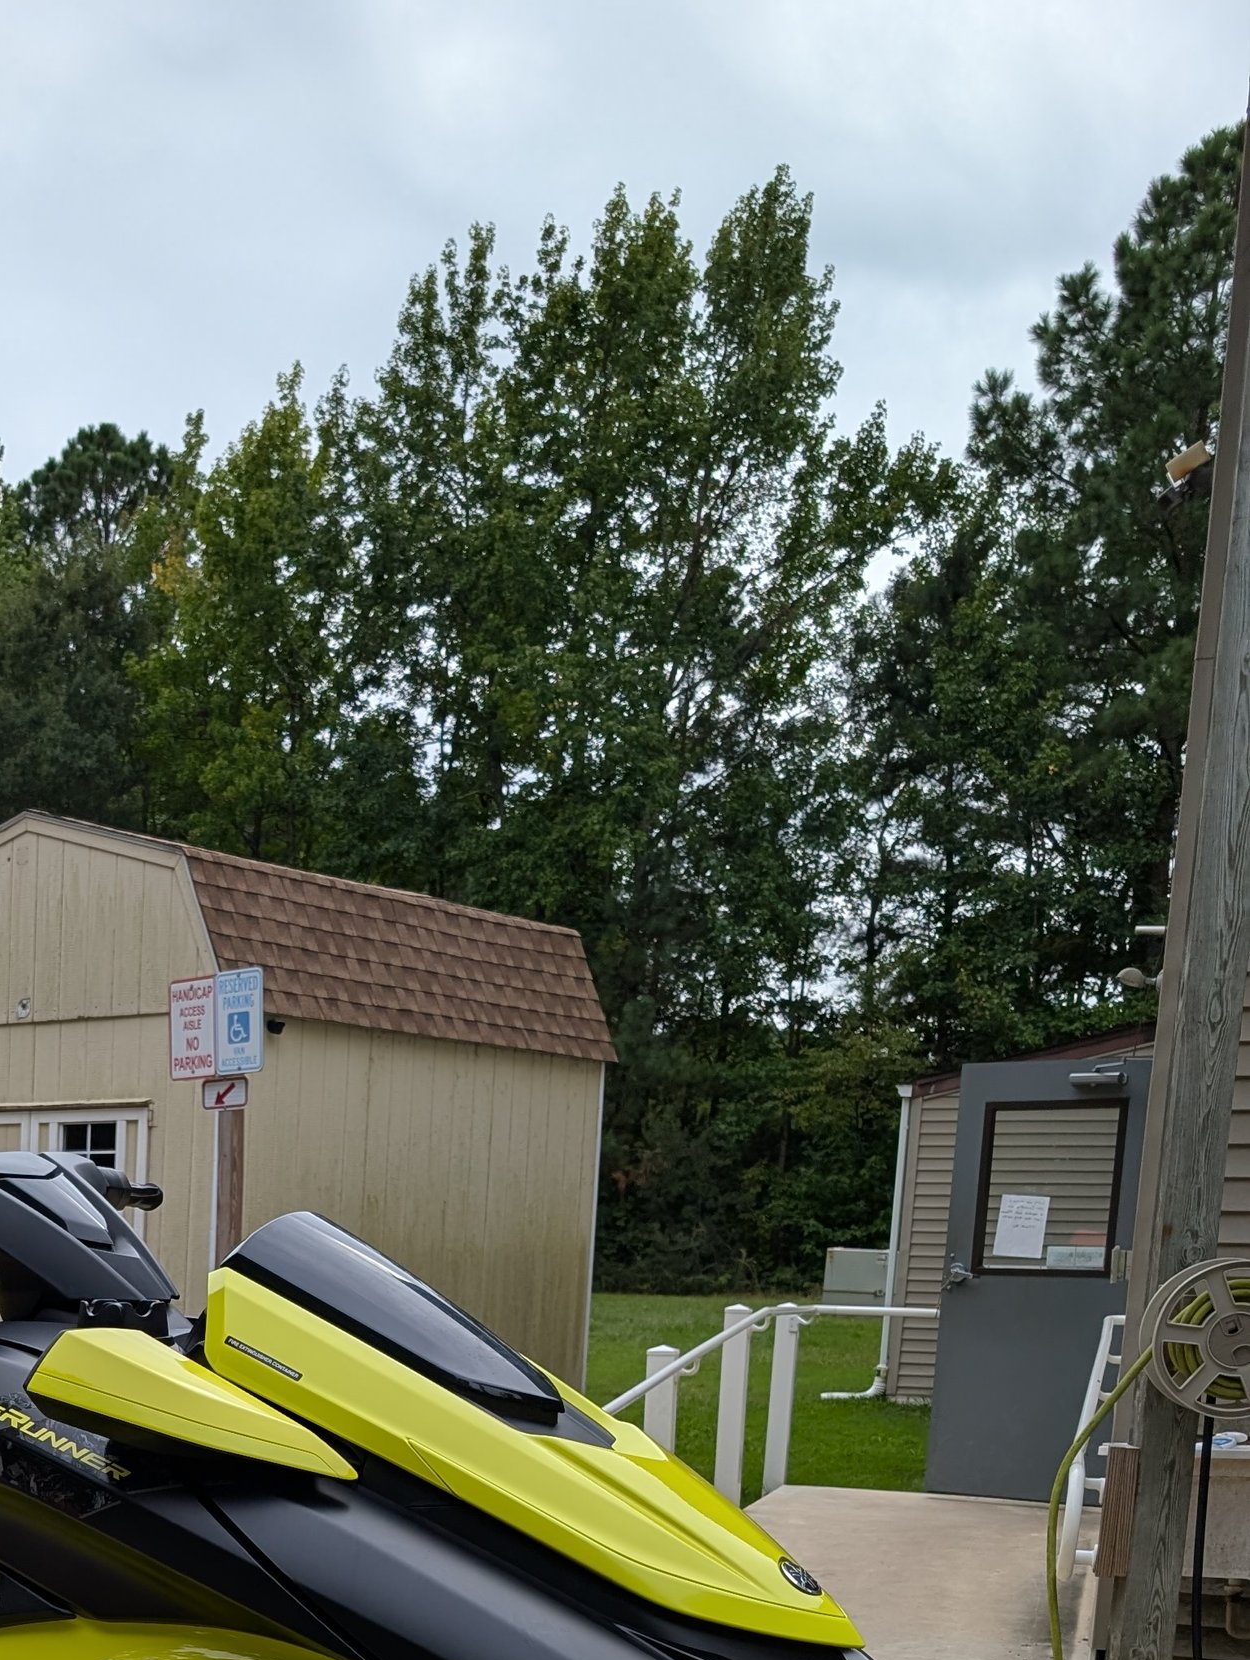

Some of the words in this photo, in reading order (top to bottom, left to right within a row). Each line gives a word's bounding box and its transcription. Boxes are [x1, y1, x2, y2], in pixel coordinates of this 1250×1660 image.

[219, 976, 258, 994] RESERVED
[172, 986, 213, 1003] HANDICAP
[222, 993, 255, 1010] PARKING
[179, 1005, 206, 1018] ACCESS
[183, 1019, 202, 1031] AISLE
[185, 1037, 200, 1051] NO
[173, 1054, 213, 1072] PARKING
[221, 1055, 258, 1067] ACCESSIBLE
